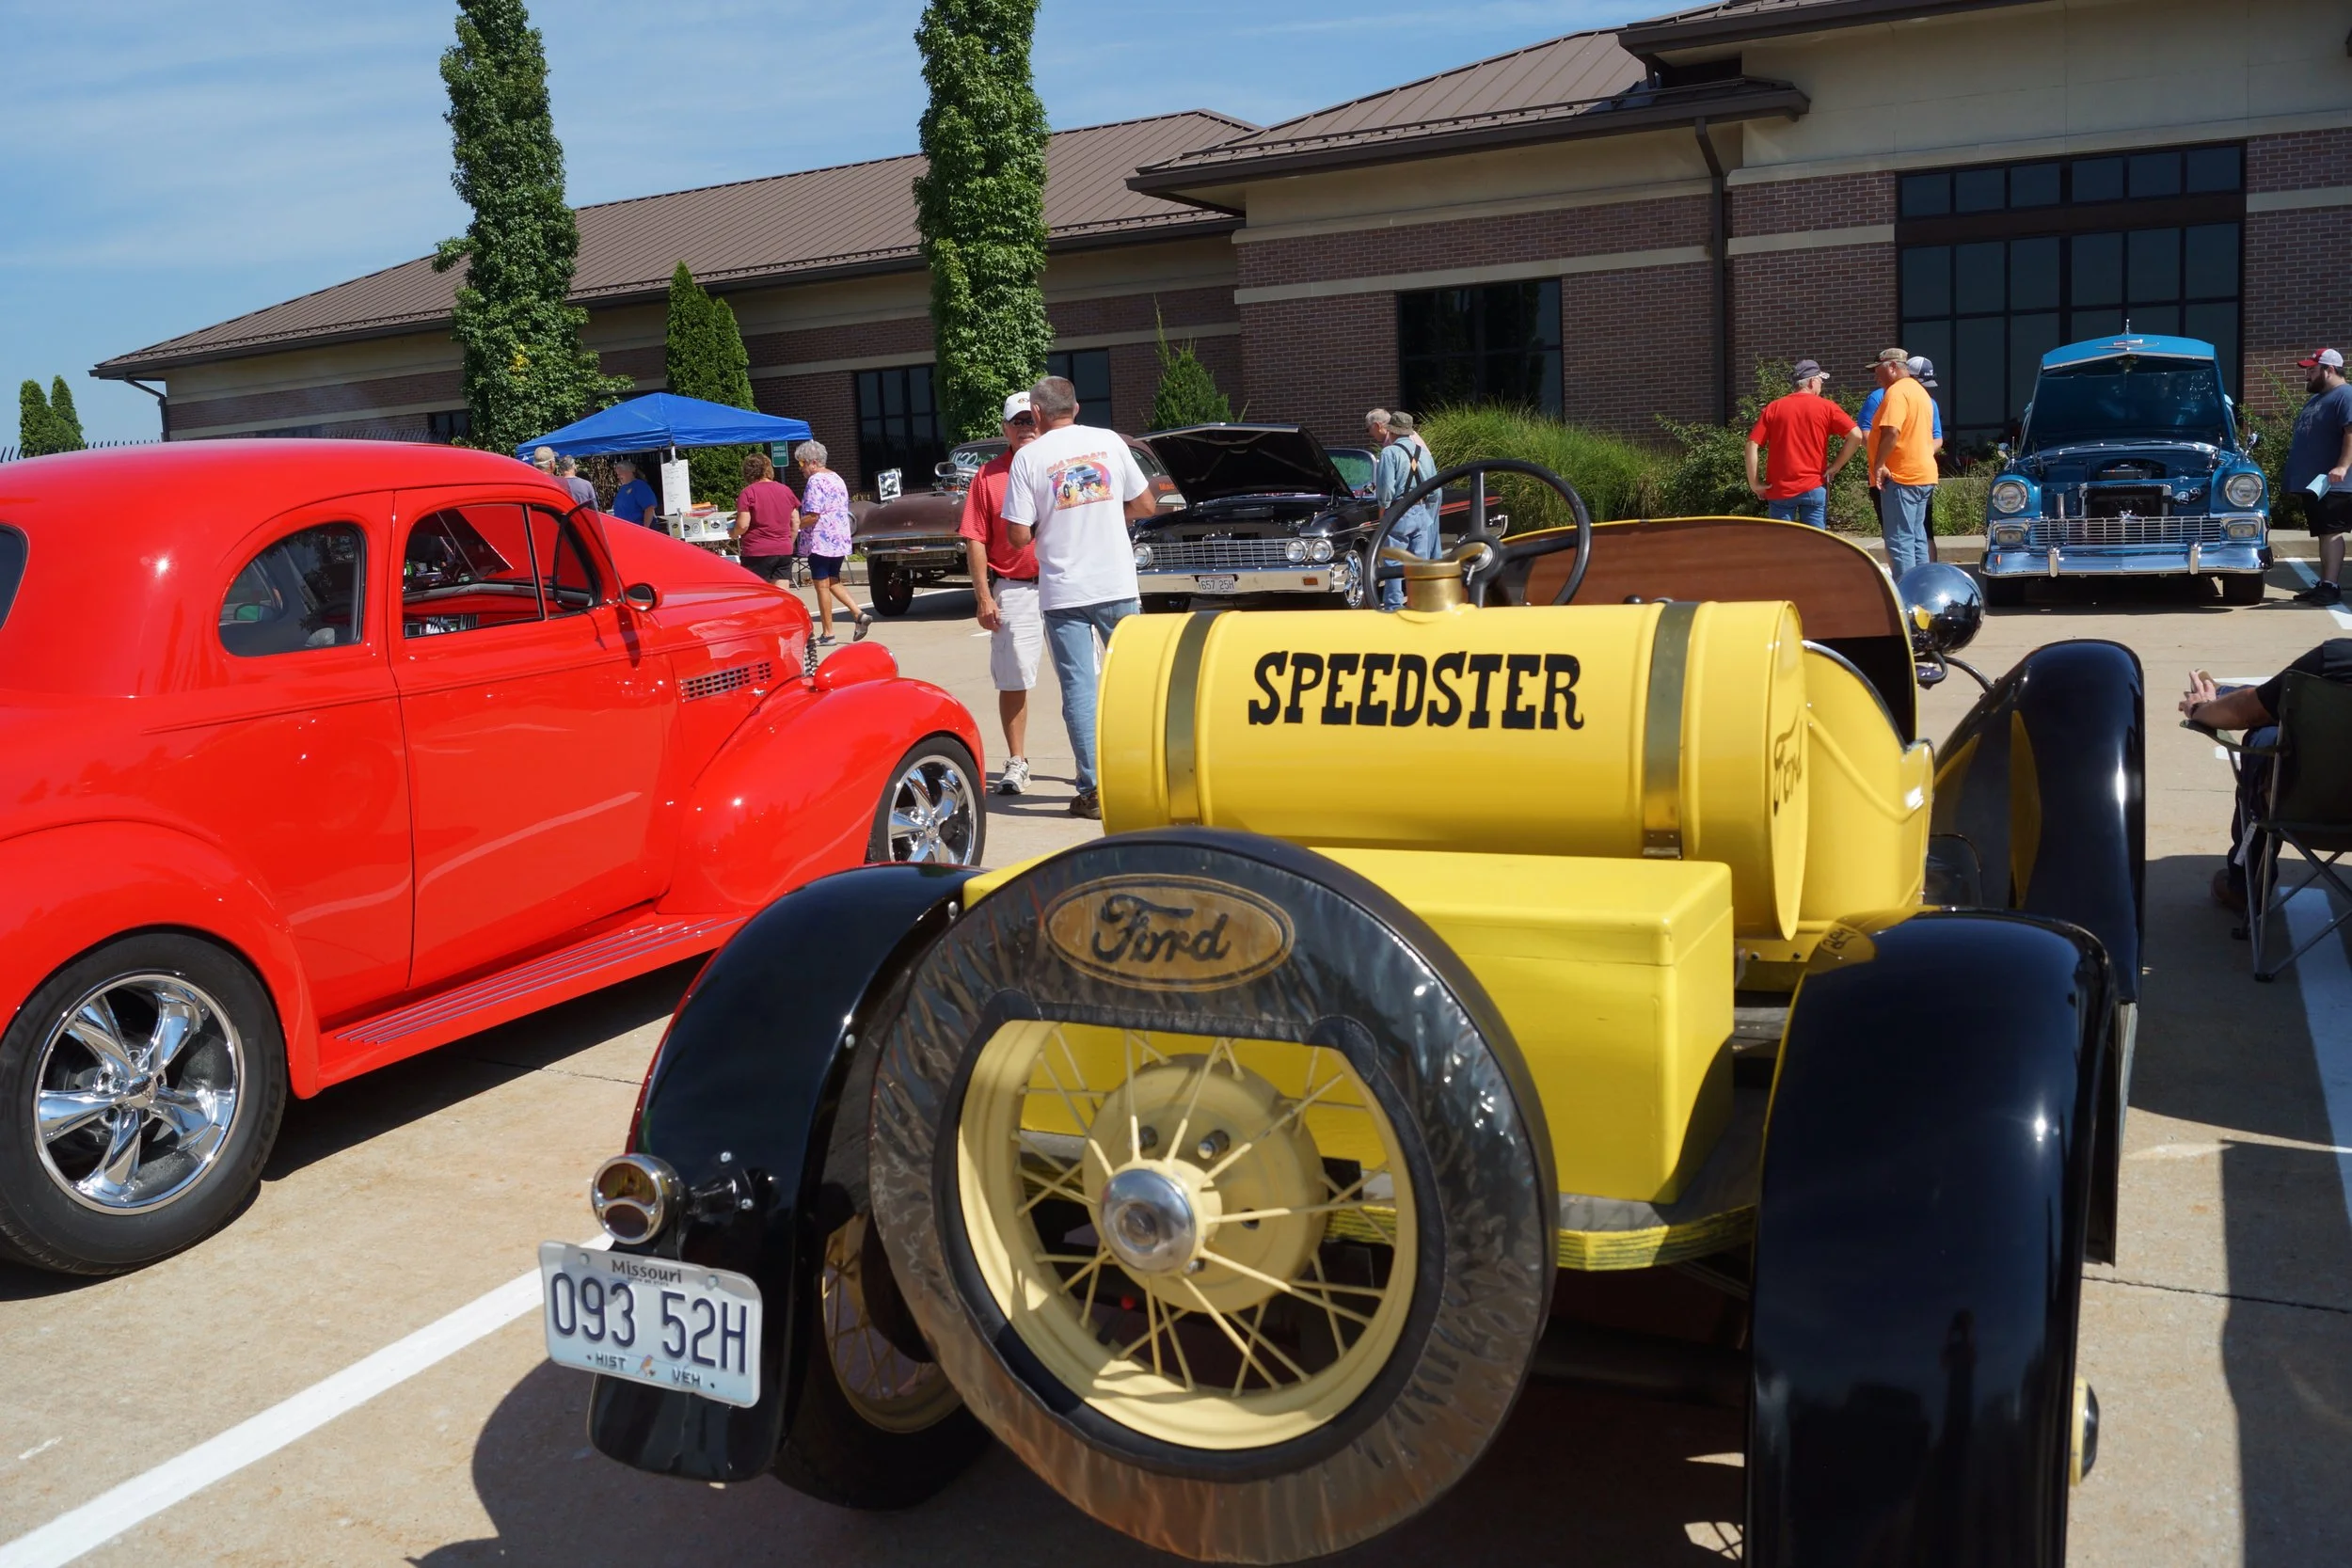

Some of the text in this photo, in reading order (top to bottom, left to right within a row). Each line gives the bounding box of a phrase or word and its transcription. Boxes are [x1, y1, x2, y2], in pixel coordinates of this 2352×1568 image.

[1200, 578, 1234, 591] 657 25H
[1248, 651, 1584, 730] SPEEDSTER
[1091, 895, 1232, 963] Ford
[612, 1259, 681, 1284] Missouri
[551, 1272, 747, 1374] 093 52H
[596, 1353, 701, 1387] HIST VEH
